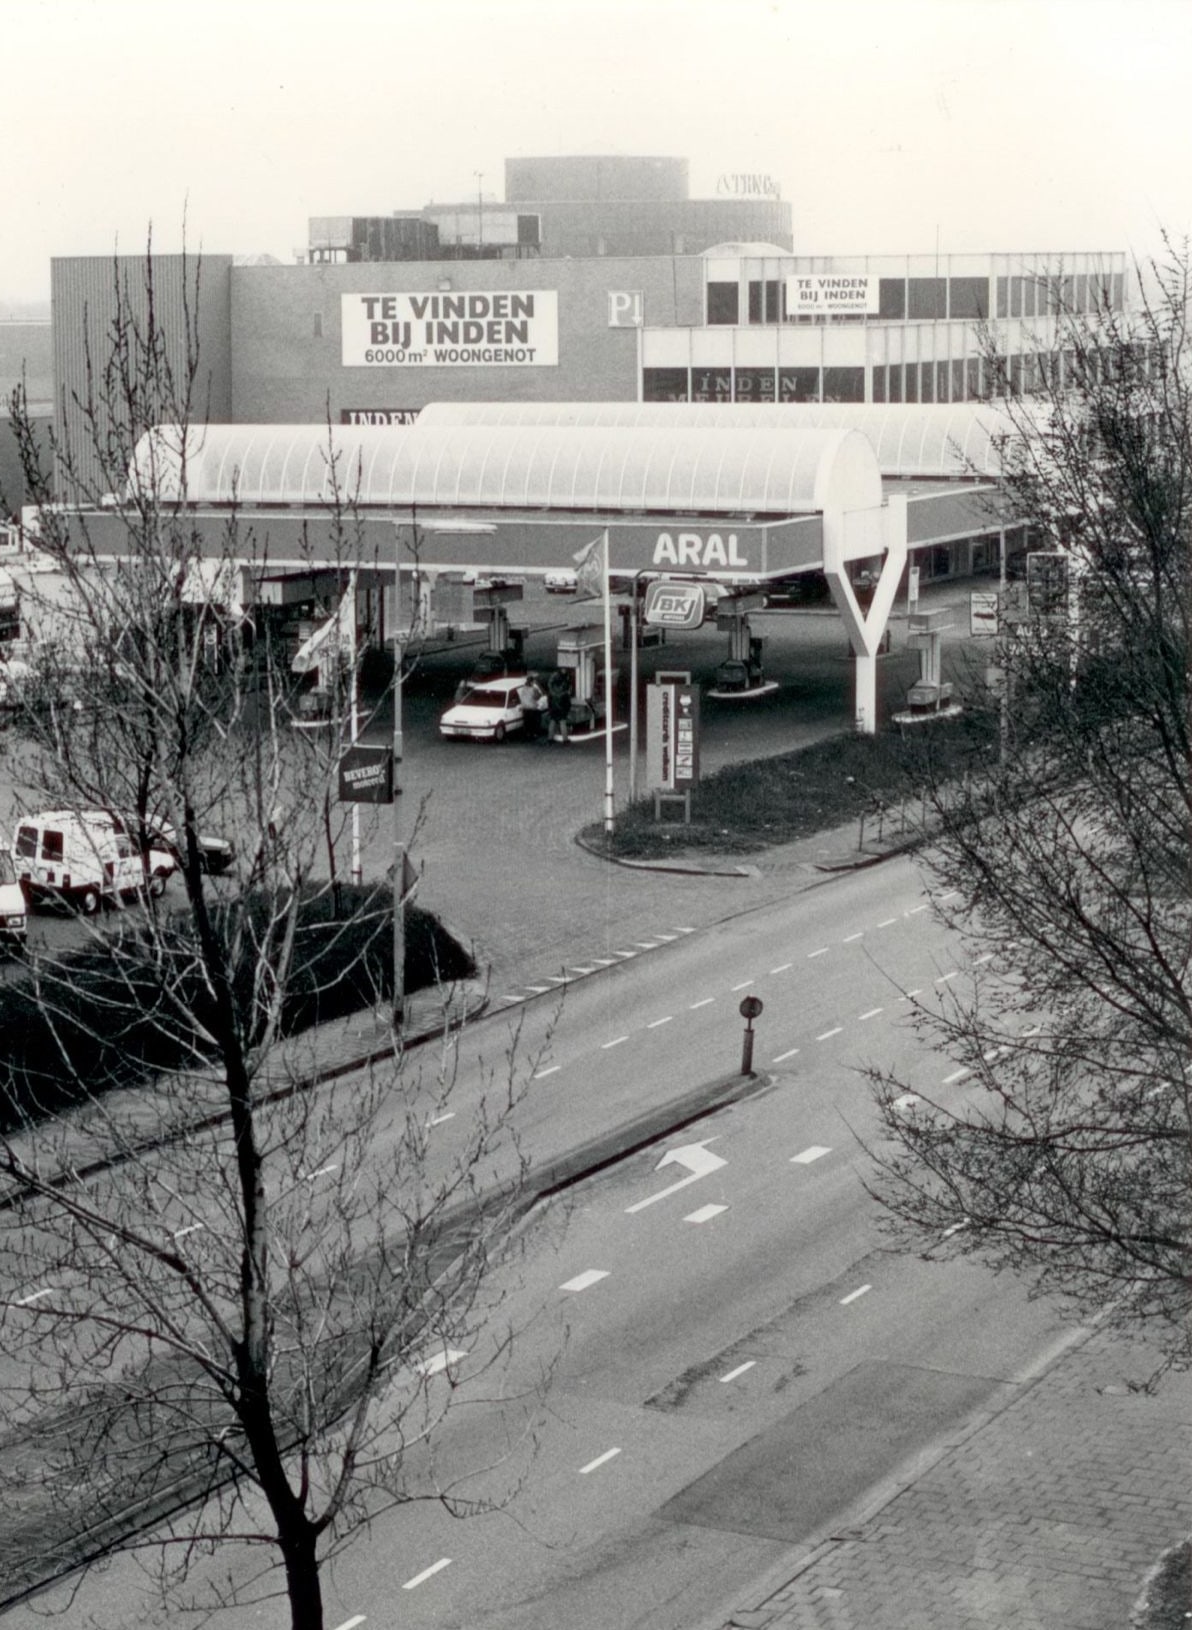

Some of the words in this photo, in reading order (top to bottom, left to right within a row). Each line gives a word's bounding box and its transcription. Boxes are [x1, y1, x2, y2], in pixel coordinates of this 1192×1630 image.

[798, 279, 812, 288] TE
[819, 278, 868, 288] VINDEN
[800, 291, 818, 302] BIJ
[824, 290, 866, 299] INDEN
[361, 296, 397, 320] TE
[408, 294, 535, 320] VINDEN
[370, 321, 412, 349] BIJ
[425, 320, 528, 345] INDEN
[365, 349, 406, 363] 6000
[434, 348, 537, 363] WOONGENOT
[701, 376, 798, 392] INDEN
[653, 533, 748, 567] ARAL
[660, 598, 687, 612] BK
